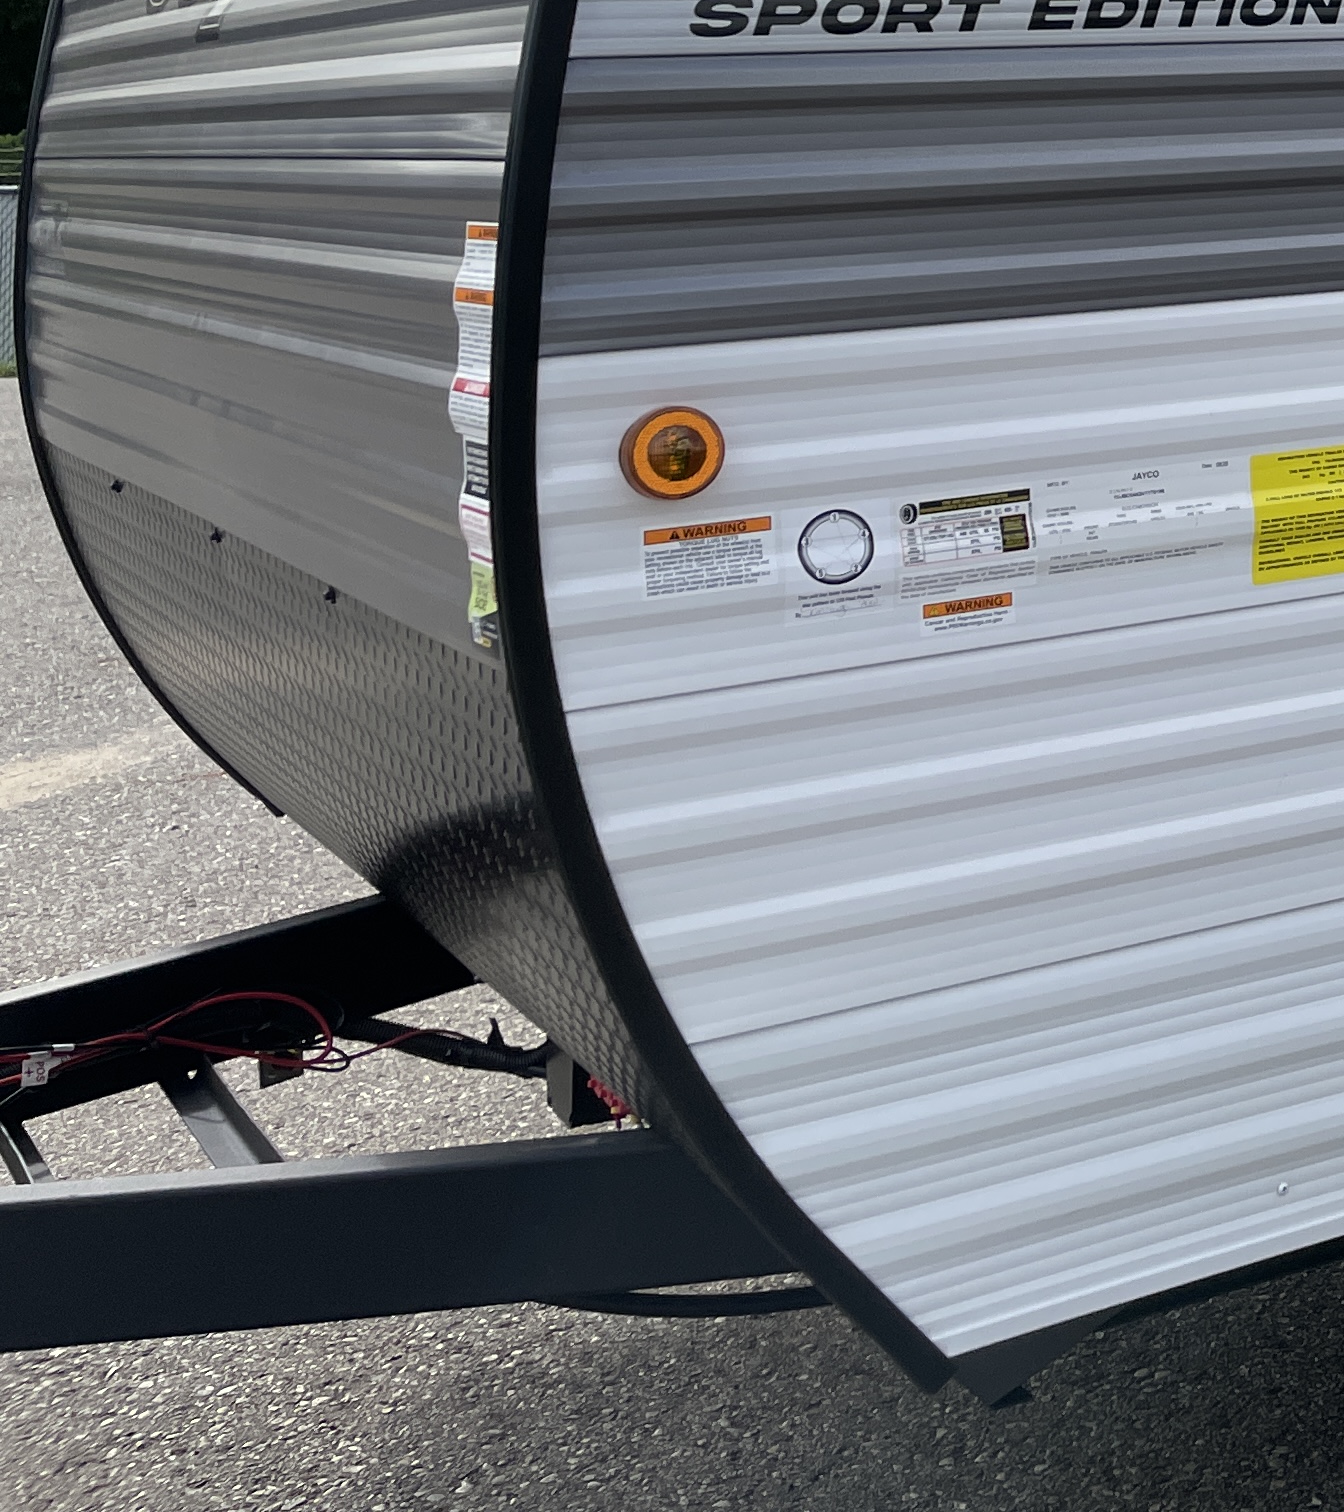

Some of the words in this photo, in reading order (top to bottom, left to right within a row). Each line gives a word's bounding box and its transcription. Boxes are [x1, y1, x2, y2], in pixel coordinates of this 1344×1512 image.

[1131, 470, 1160, 481] JAYCO
[683, 520, 748, 539] WARNING
[944, 596, 1004, 613] WARNING
